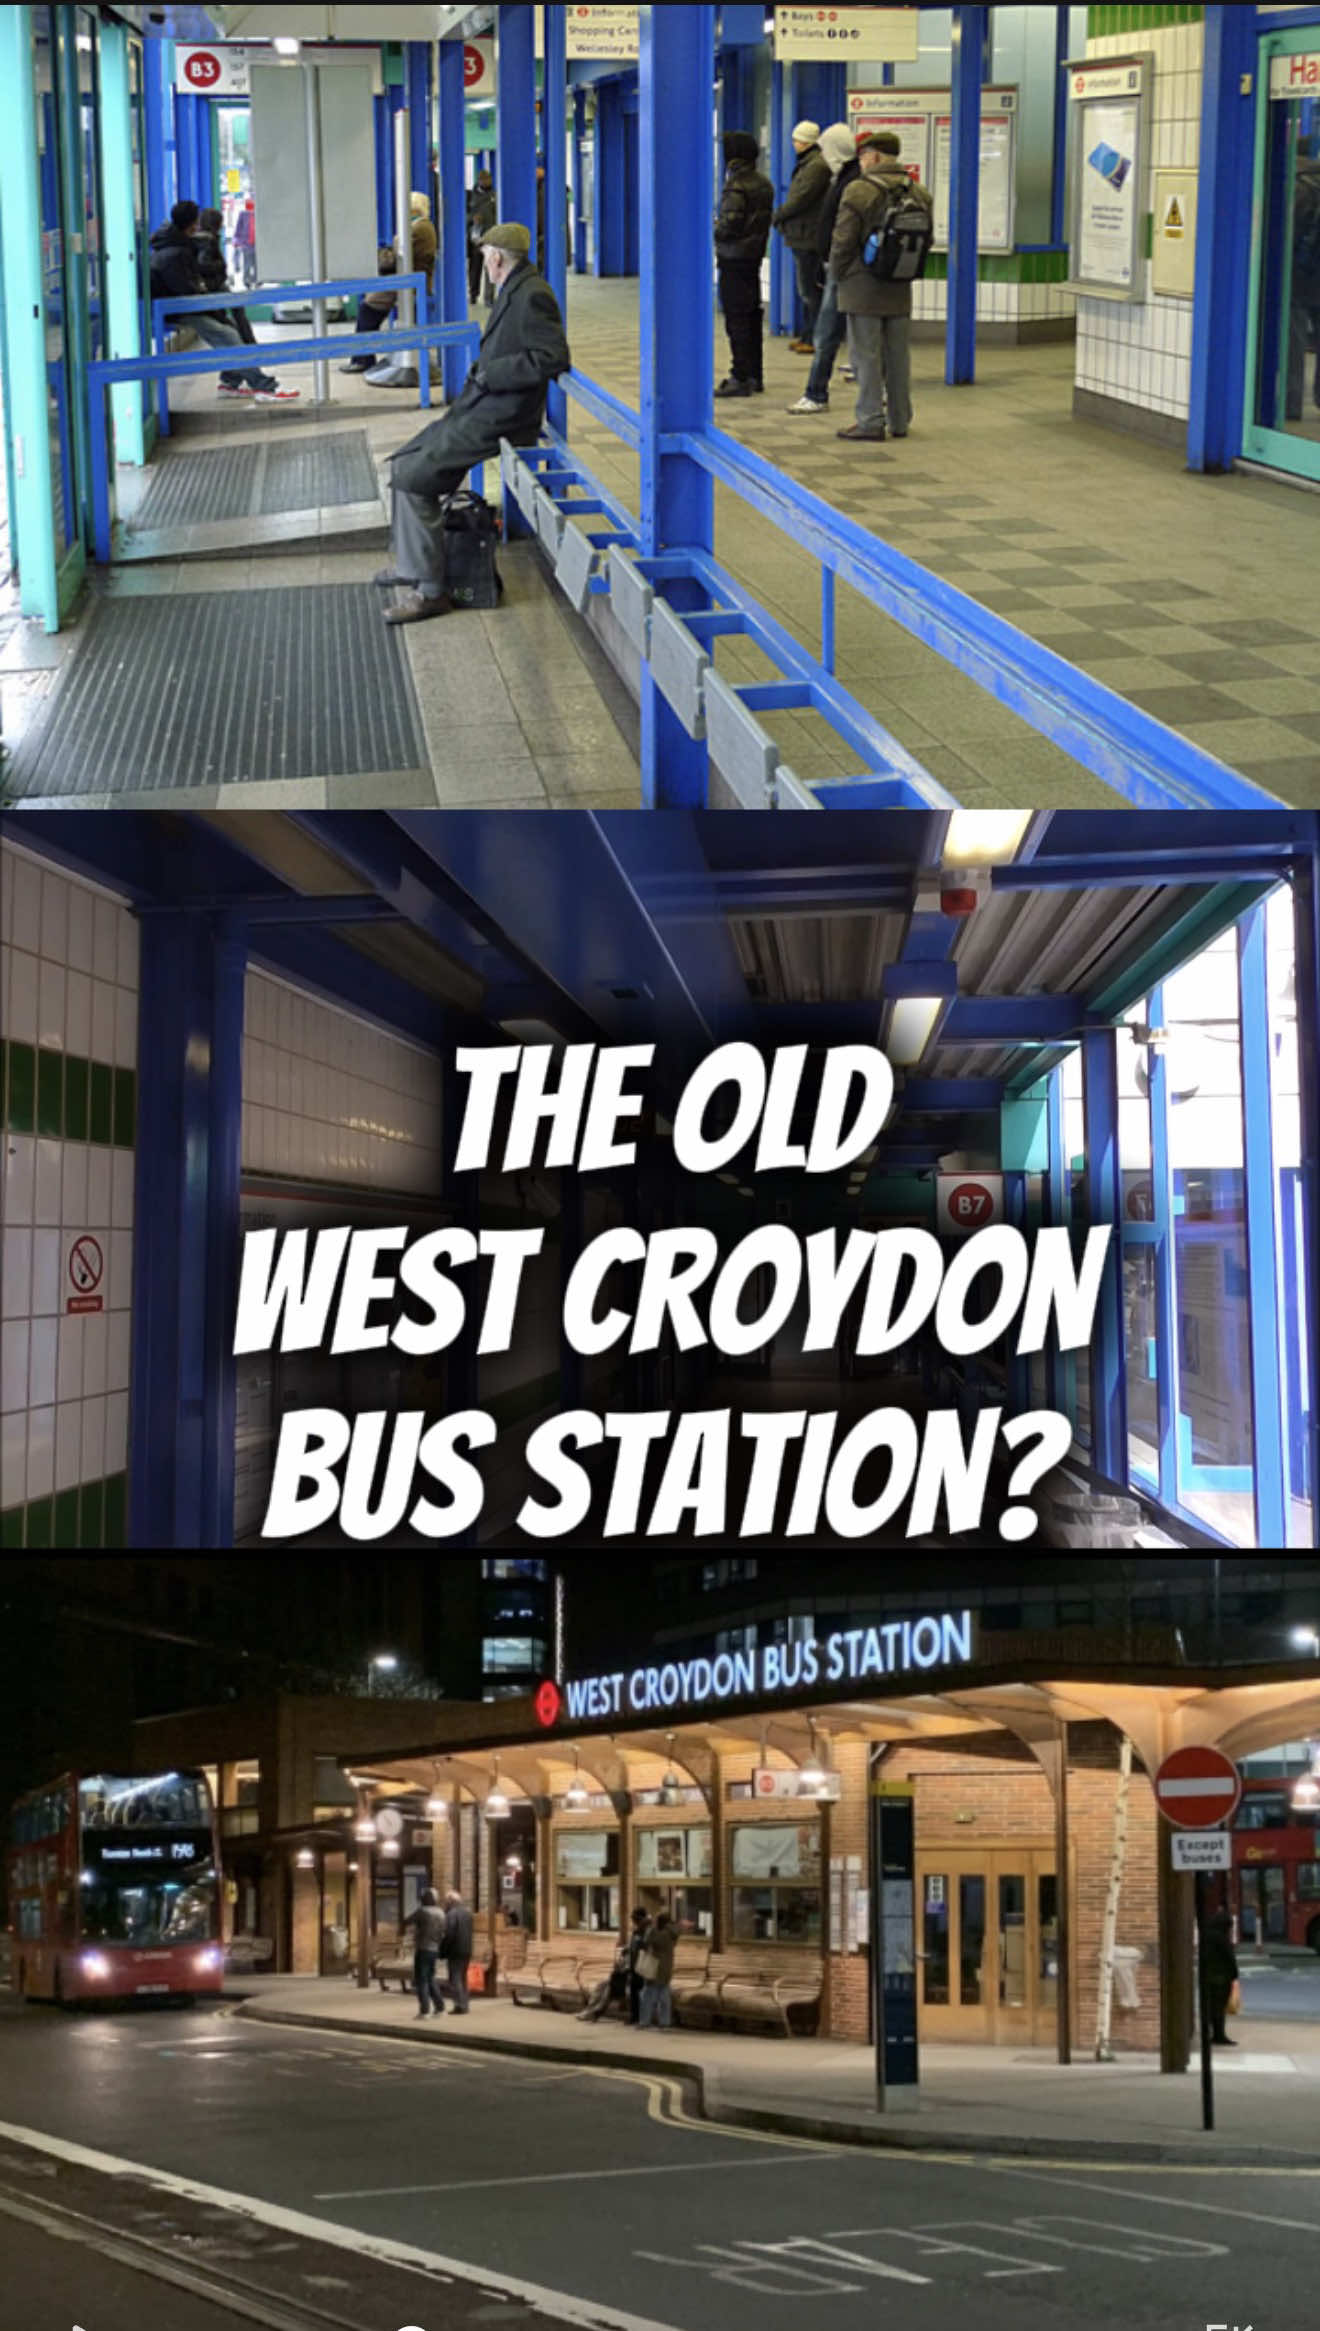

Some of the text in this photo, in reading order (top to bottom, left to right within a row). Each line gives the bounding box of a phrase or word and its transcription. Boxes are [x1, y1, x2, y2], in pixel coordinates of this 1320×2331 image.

[568, 26, 614, 37] Shopping
[576, 43, 624, 56] Wellesley
[191, 62, 215, 78] B3
[957, 1195, 986, 1215] B7
[566, 1610, 972, 1718] WEST CROYDON BUS STATION
[1177, 1838, 1224, 1854] Except
[1181, 1852, 1222, 1864] buses
